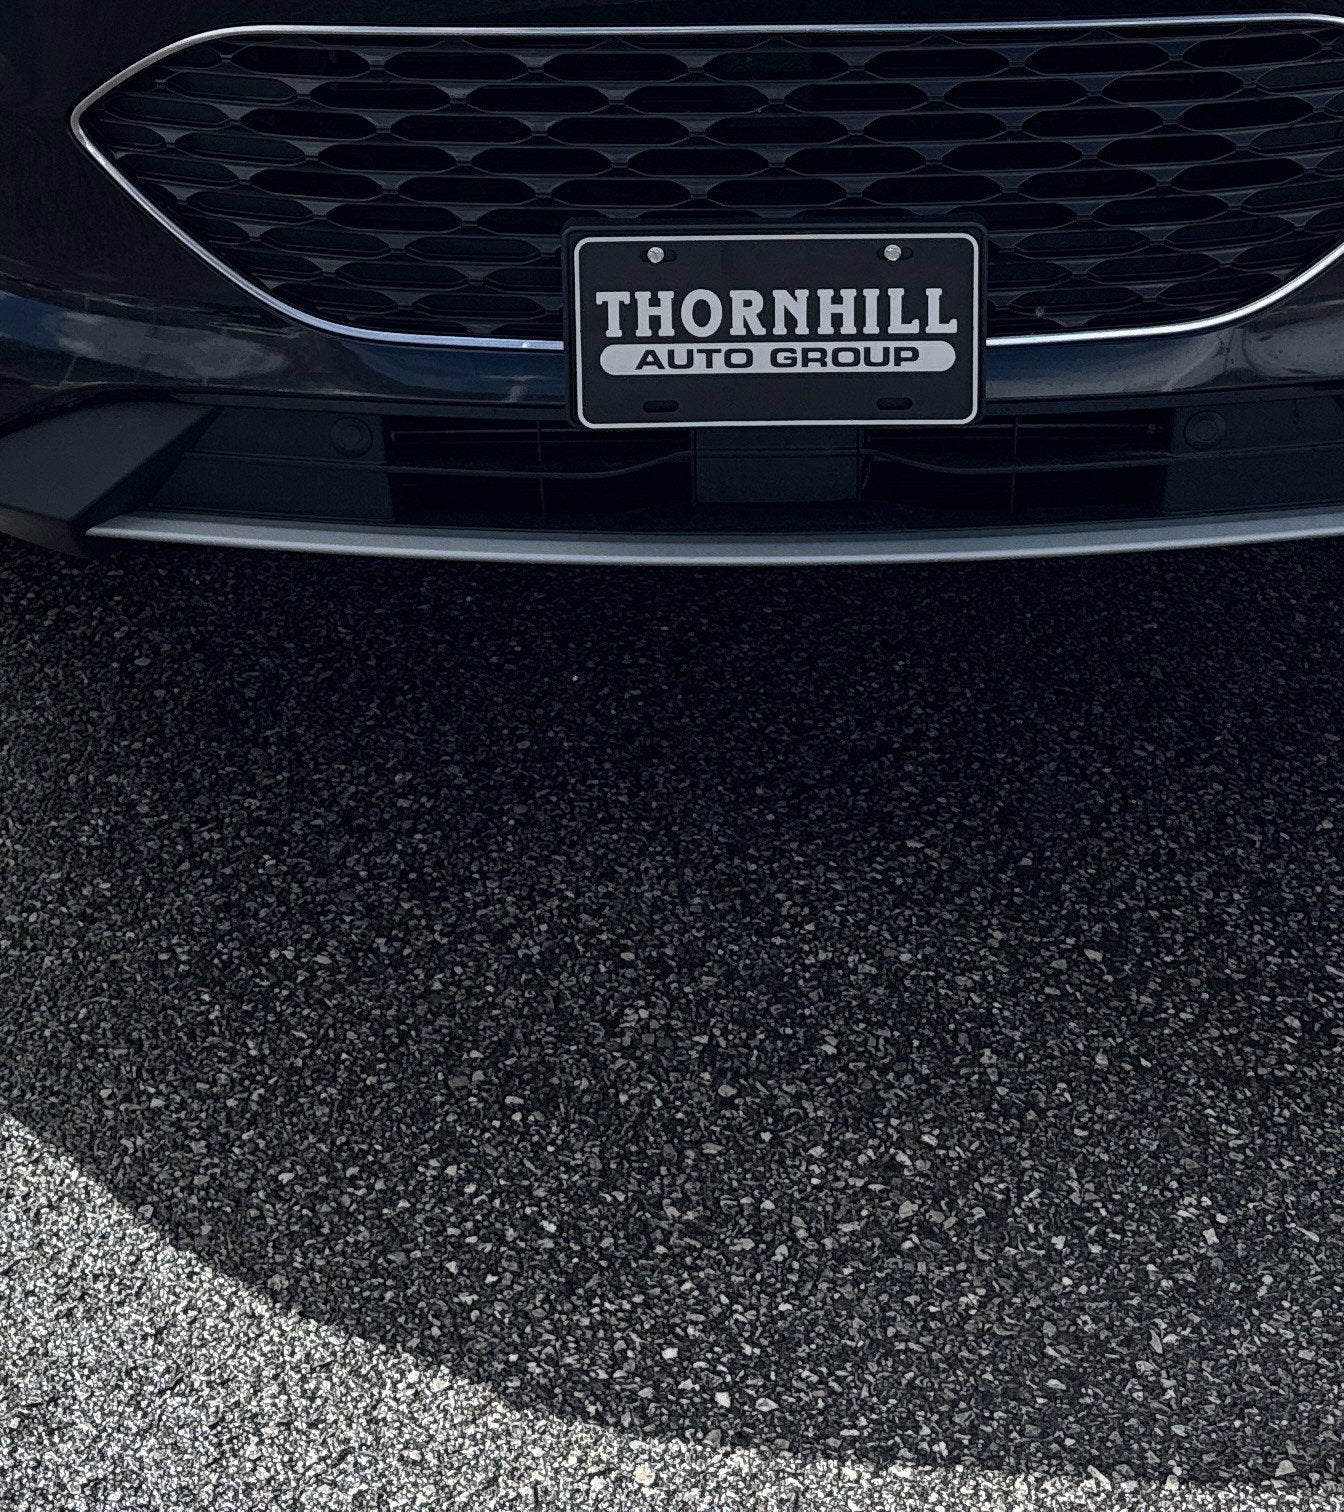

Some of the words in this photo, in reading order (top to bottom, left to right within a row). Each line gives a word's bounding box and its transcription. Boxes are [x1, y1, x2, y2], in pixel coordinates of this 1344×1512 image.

[596, 287, 958, 338] THORNHILL
[635, 347, 755, 371] AUTO
[770, 346, 920, 368] GROUP
